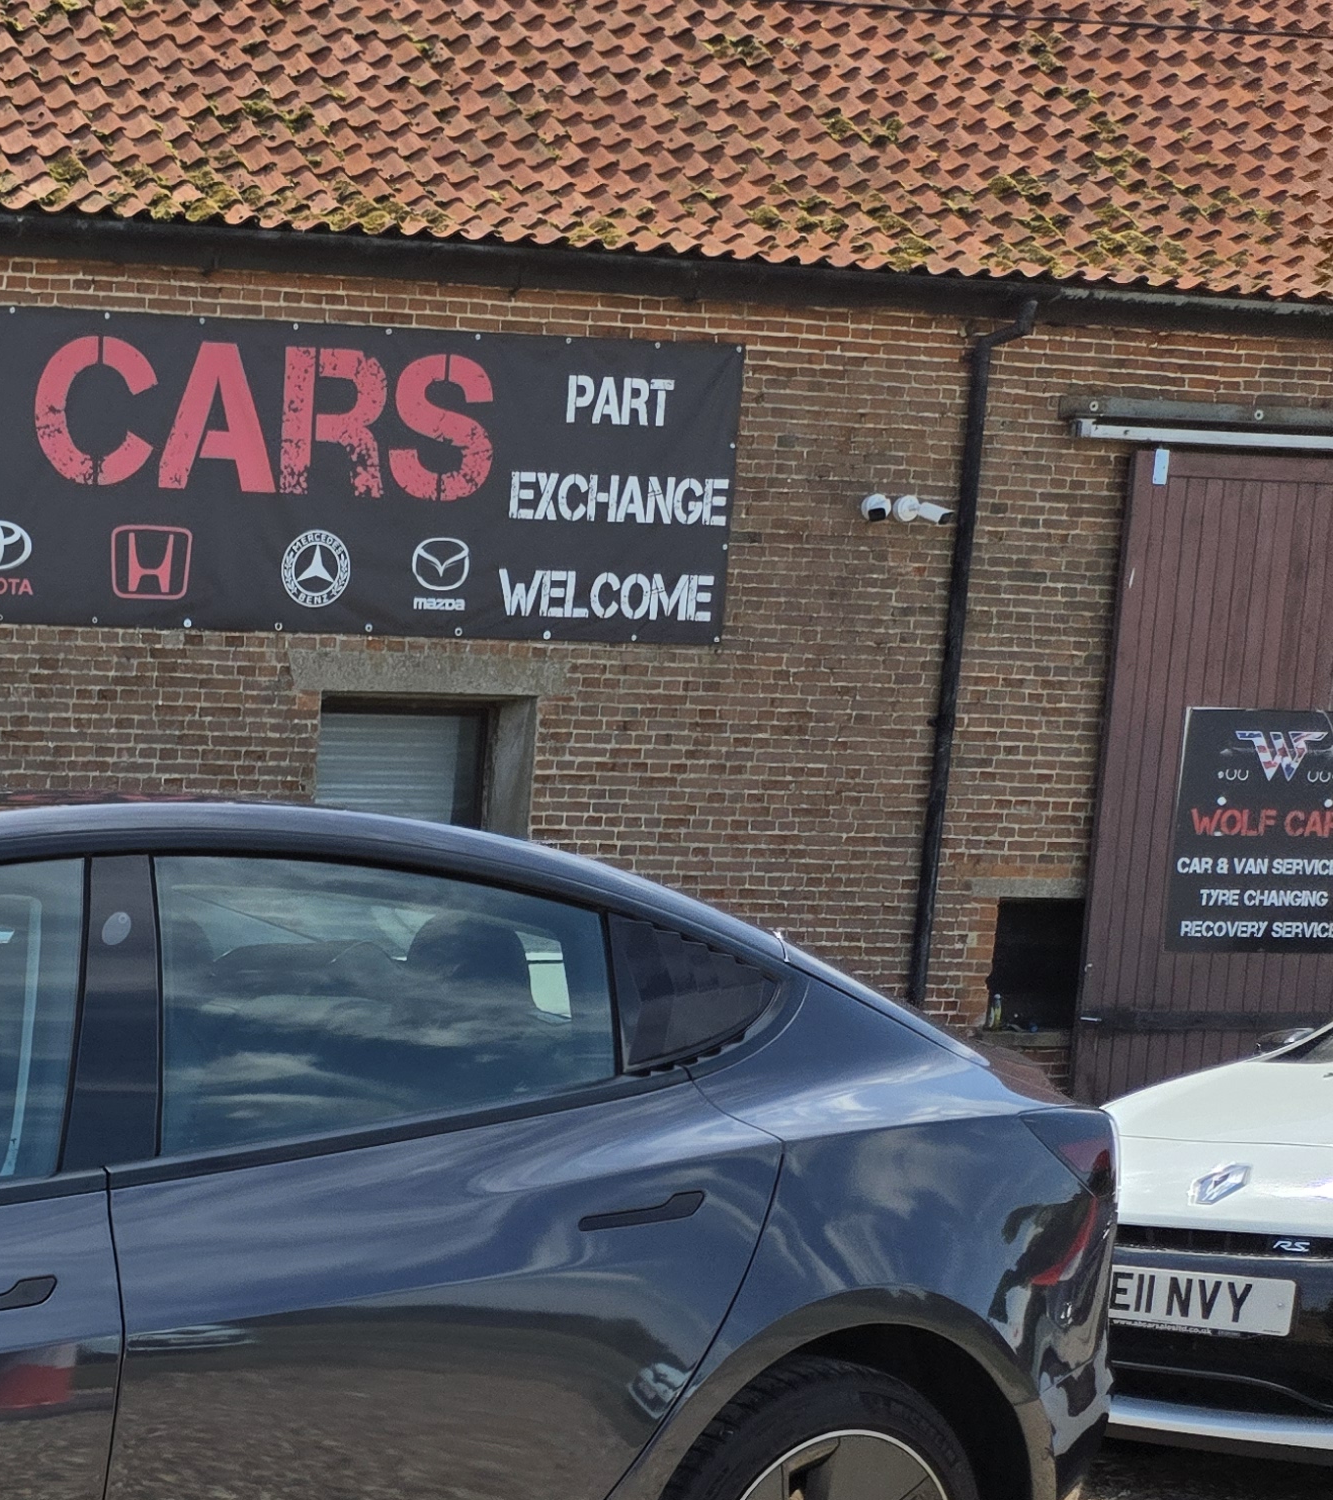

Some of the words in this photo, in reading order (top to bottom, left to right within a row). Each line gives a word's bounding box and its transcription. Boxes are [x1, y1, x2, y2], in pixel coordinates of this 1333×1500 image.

[565, 375, 675, 427] PART
[34, 335, 494, 501] CARS
[508, 471, 729, 526] EXCHANGE
[292, 533, 343, 555] MERCEDES
[298, 593, 329, 605] BENZ
[498, 568, 715, 622] WELCOME
[1190, 807, 1278, 836] WOLF
[1177, 857, 1213, 874] CAR
[1216, 857, 1229, 874] &
[1233, 858, 1269, 875] VAN
[1200, 889, 1240, 906] TYRE
[1244, 890, 1328, 907] CHANGING
[1180, 921, 1268, 937] RECOVERY
[1273, 1240, 1311, 1252] RS
[1165, 1276, 1253, 1323] NVY
